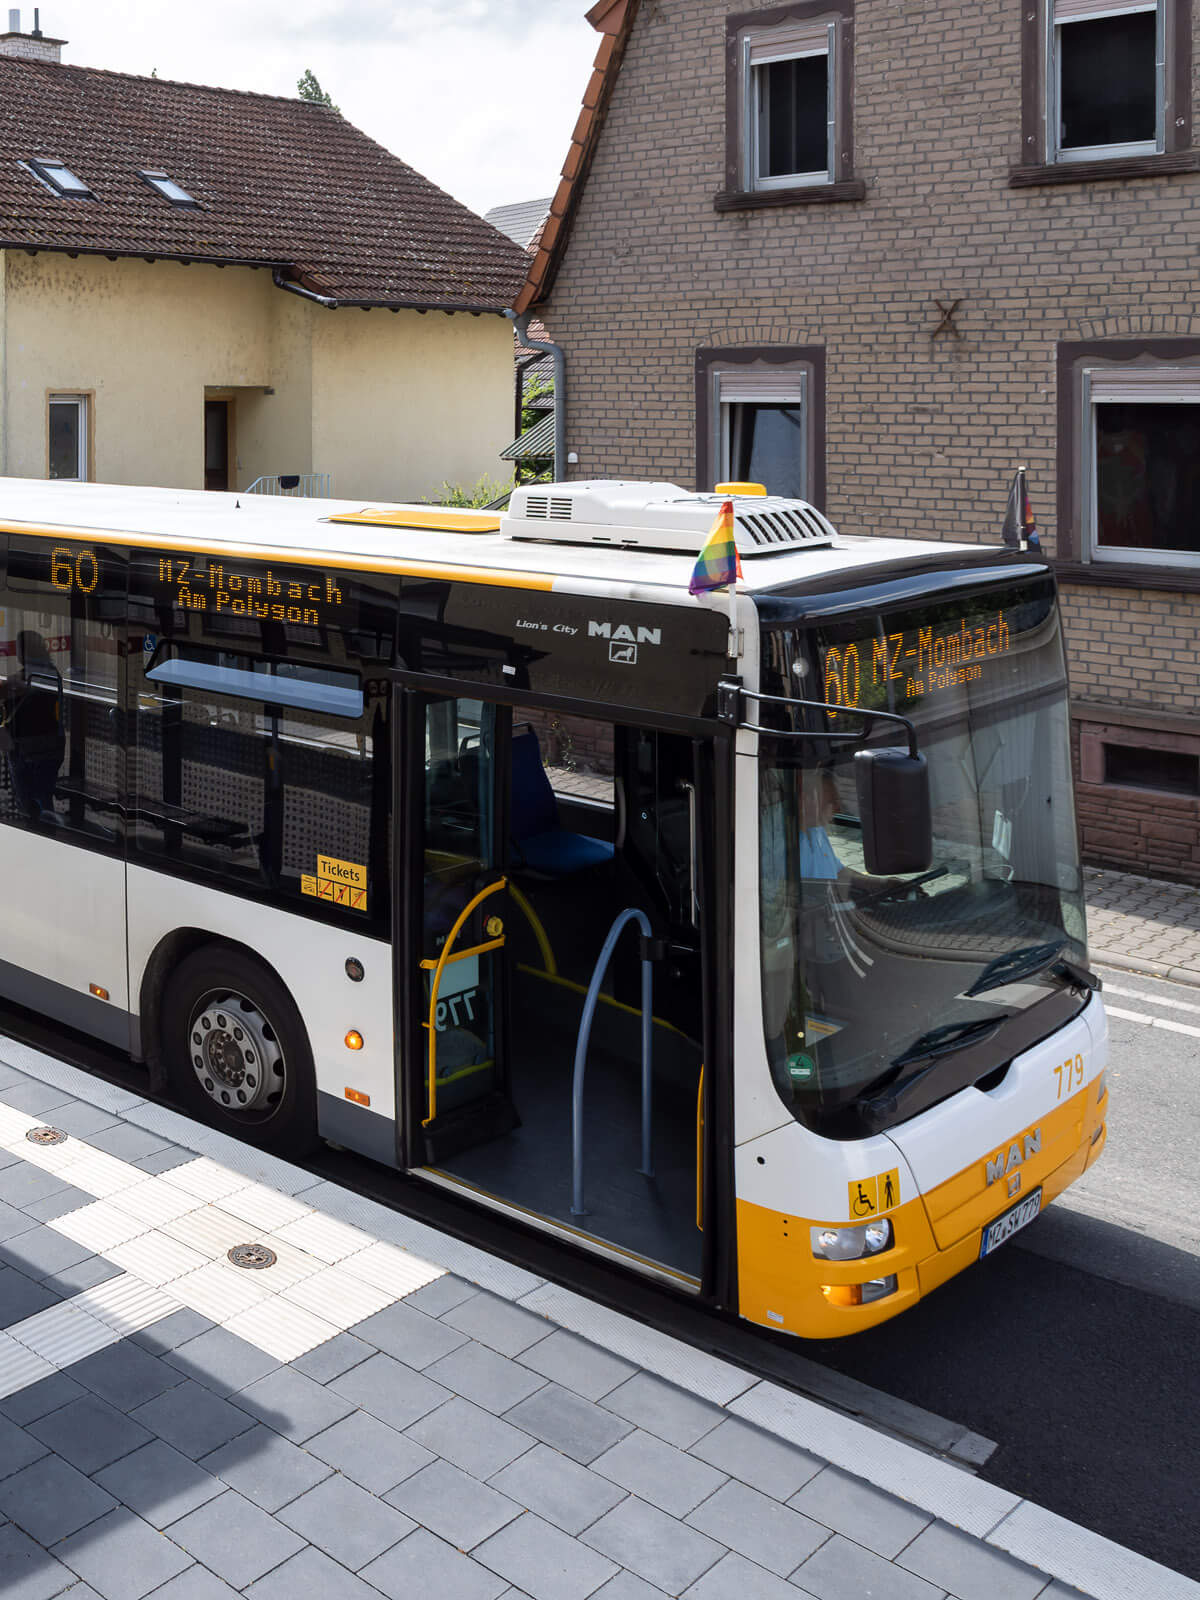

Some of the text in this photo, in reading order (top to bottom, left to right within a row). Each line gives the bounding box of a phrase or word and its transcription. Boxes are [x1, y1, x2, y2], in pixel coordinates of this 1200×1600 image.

[50, 546, 99, 594] 60
[158, 558, 344, 605] MZ-Mombach
[177, 585, 320, 626] Am Polygon
[515, 618, 579, 636] Lion's City
[587, 620, 662, 646] MAN
[871, 609, 1010, 685] MZ-Mombach
[824, 642, 861, 719] 60
[905, 663, 983, 698] Am Polygon
[320, 860, 360, 882] Tickets
[1053, 1053, 1085, 1100] 779
[985, 1127, 1042, 1187] MAN
